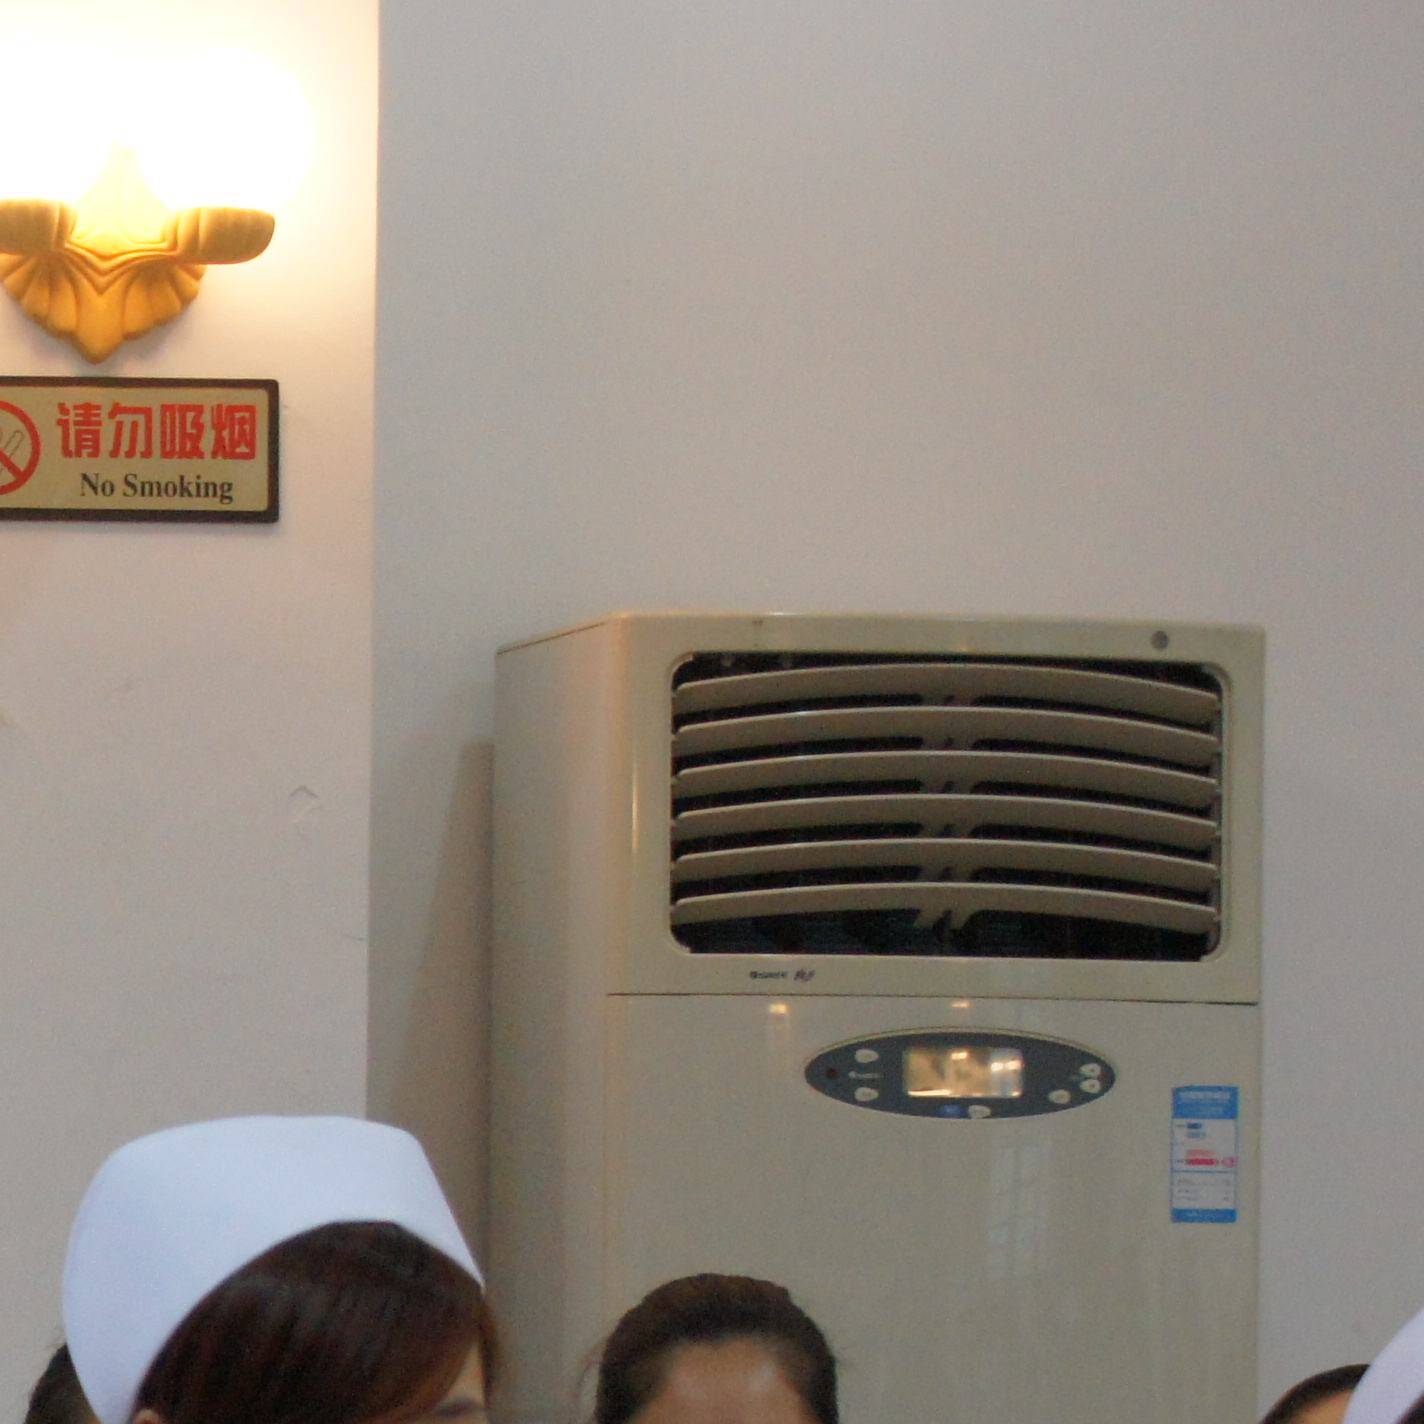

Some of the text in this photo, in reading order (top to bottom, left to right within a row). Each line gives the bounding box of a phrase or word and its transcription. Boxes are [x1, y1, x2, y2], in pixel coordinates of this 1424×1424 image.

[55, 401, 257, 461] 请勿吸烟
[79, 472, 235, 504] No Smoking
